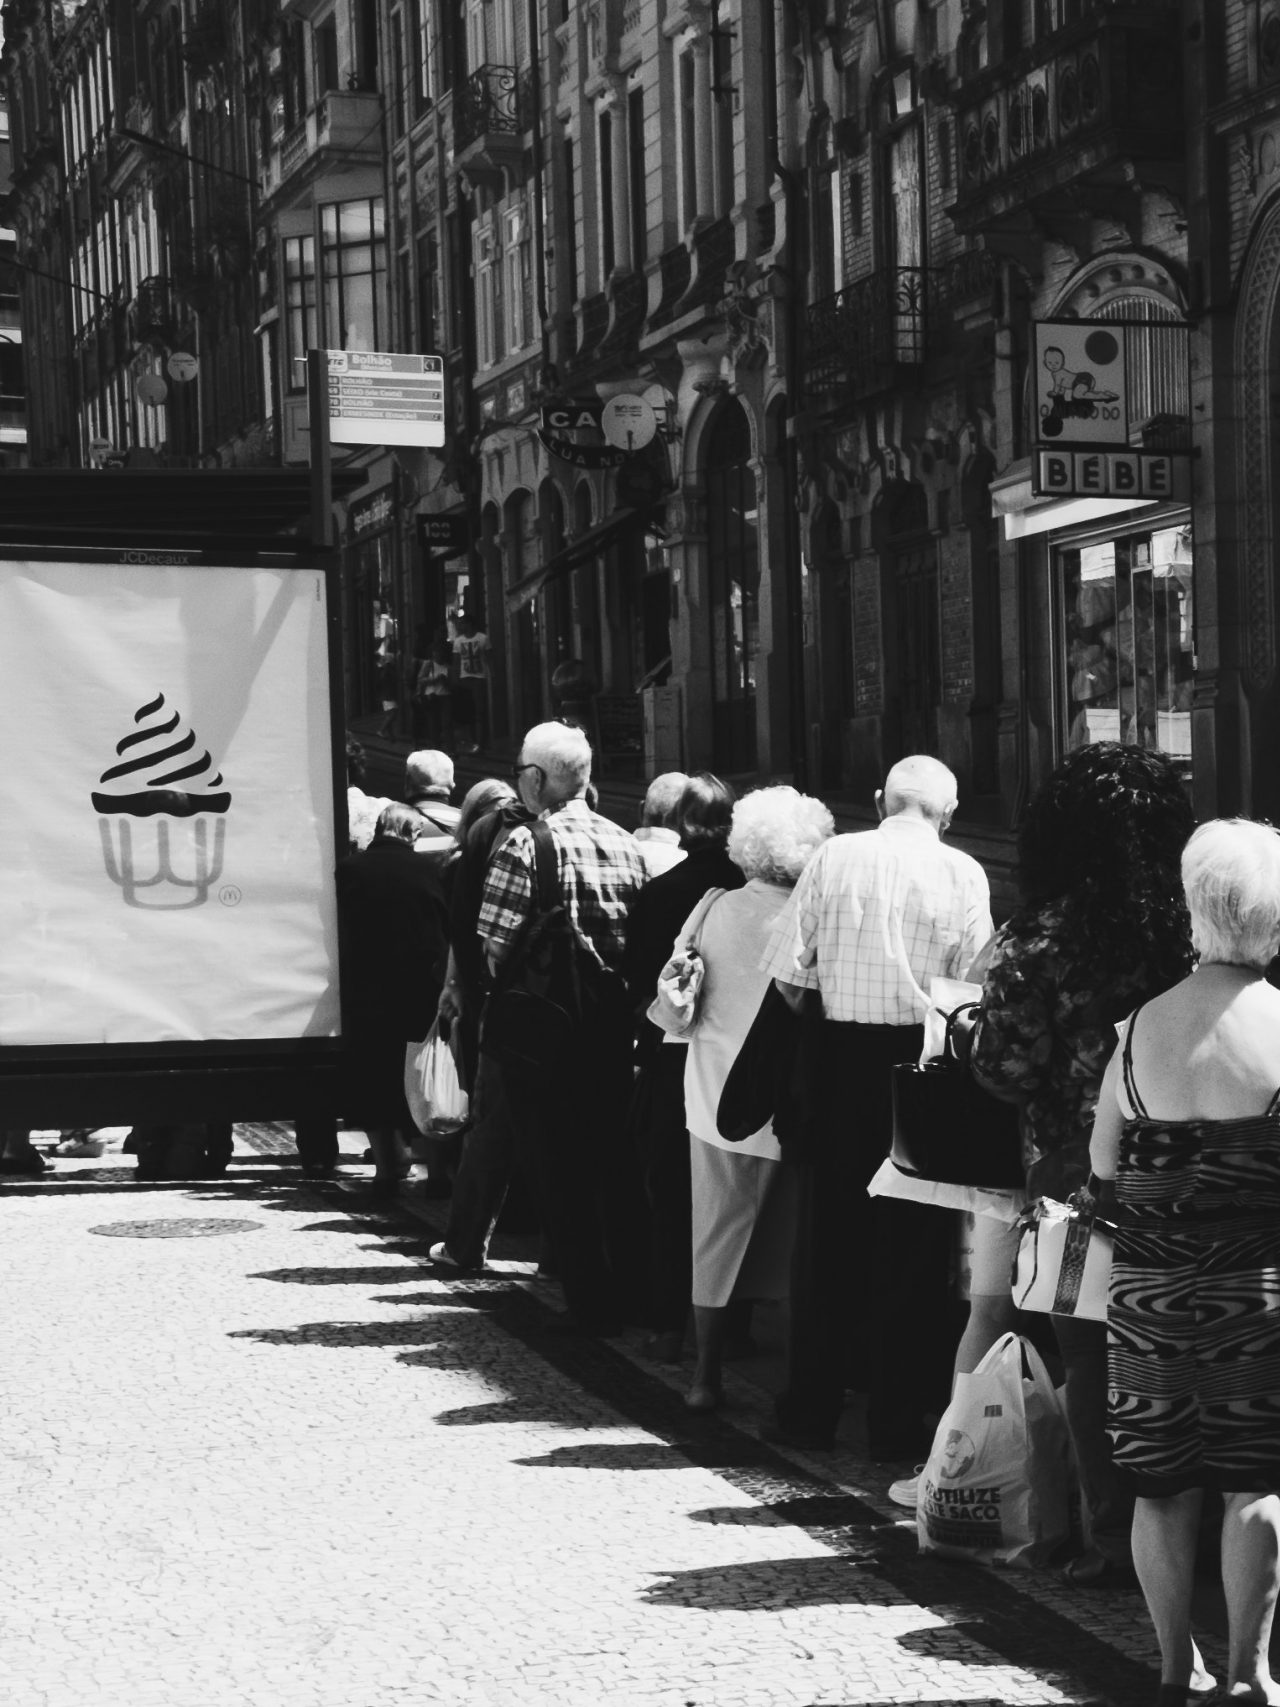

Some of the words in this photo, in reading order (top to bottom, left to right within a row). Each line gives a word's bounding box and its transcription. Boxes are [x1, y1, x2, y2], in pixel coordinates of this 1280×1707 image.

[352, 354, 393, 366] Bolhão
[1102, 406, 1120, 421] DO
[1047, 456, 1166, 490] BÉBÉ
[120, 551, 189, 565] JCDecaux
[949, 1505, 1001, 1521] SACO
